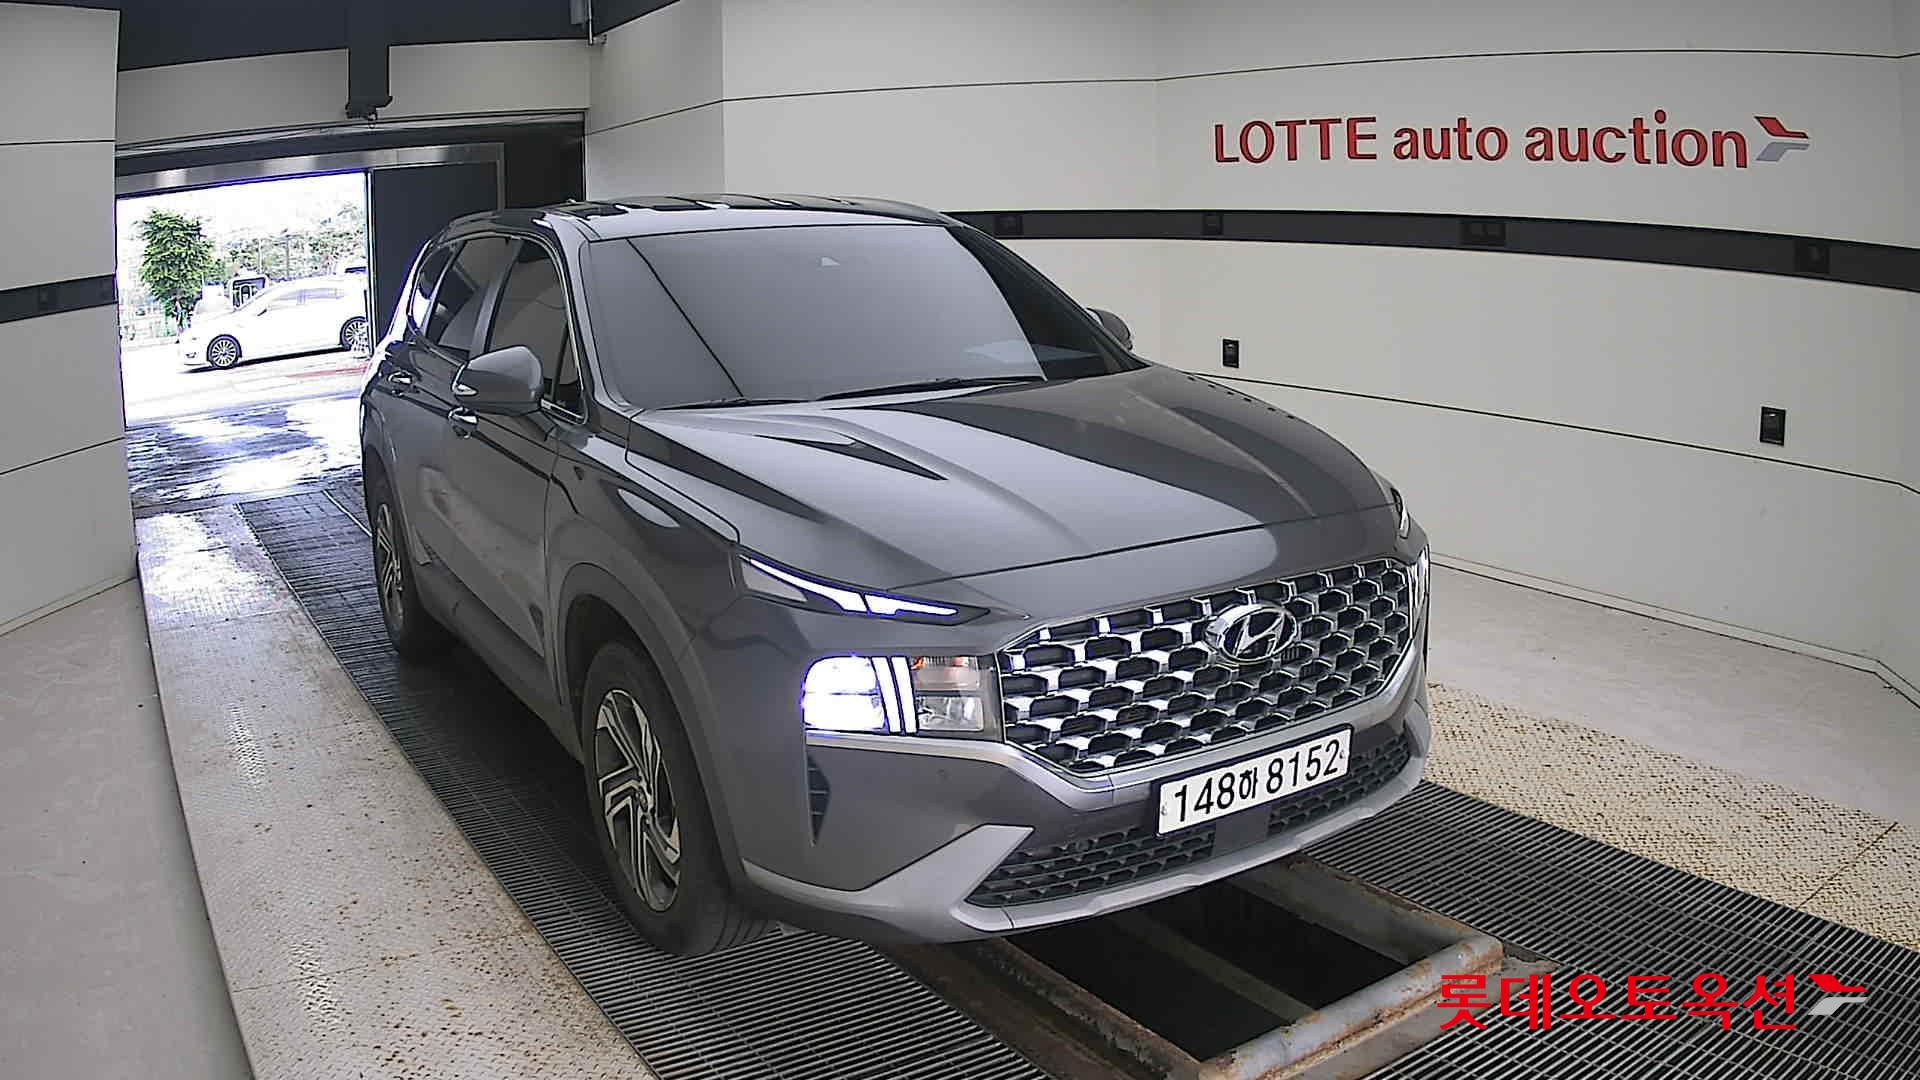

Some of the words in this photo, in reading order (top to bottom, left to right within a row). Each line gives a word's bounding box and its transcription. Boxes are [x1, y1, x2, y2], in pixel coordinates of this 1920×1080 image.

[1214, 116, 1377, 163] LOTTE
[1393, 117, 1509, 161] auto
[1524, 110, 1748, 168] auction
[1174, 767, 1259, 822] 148하
[1266, 739, 1340, 794] 8152
